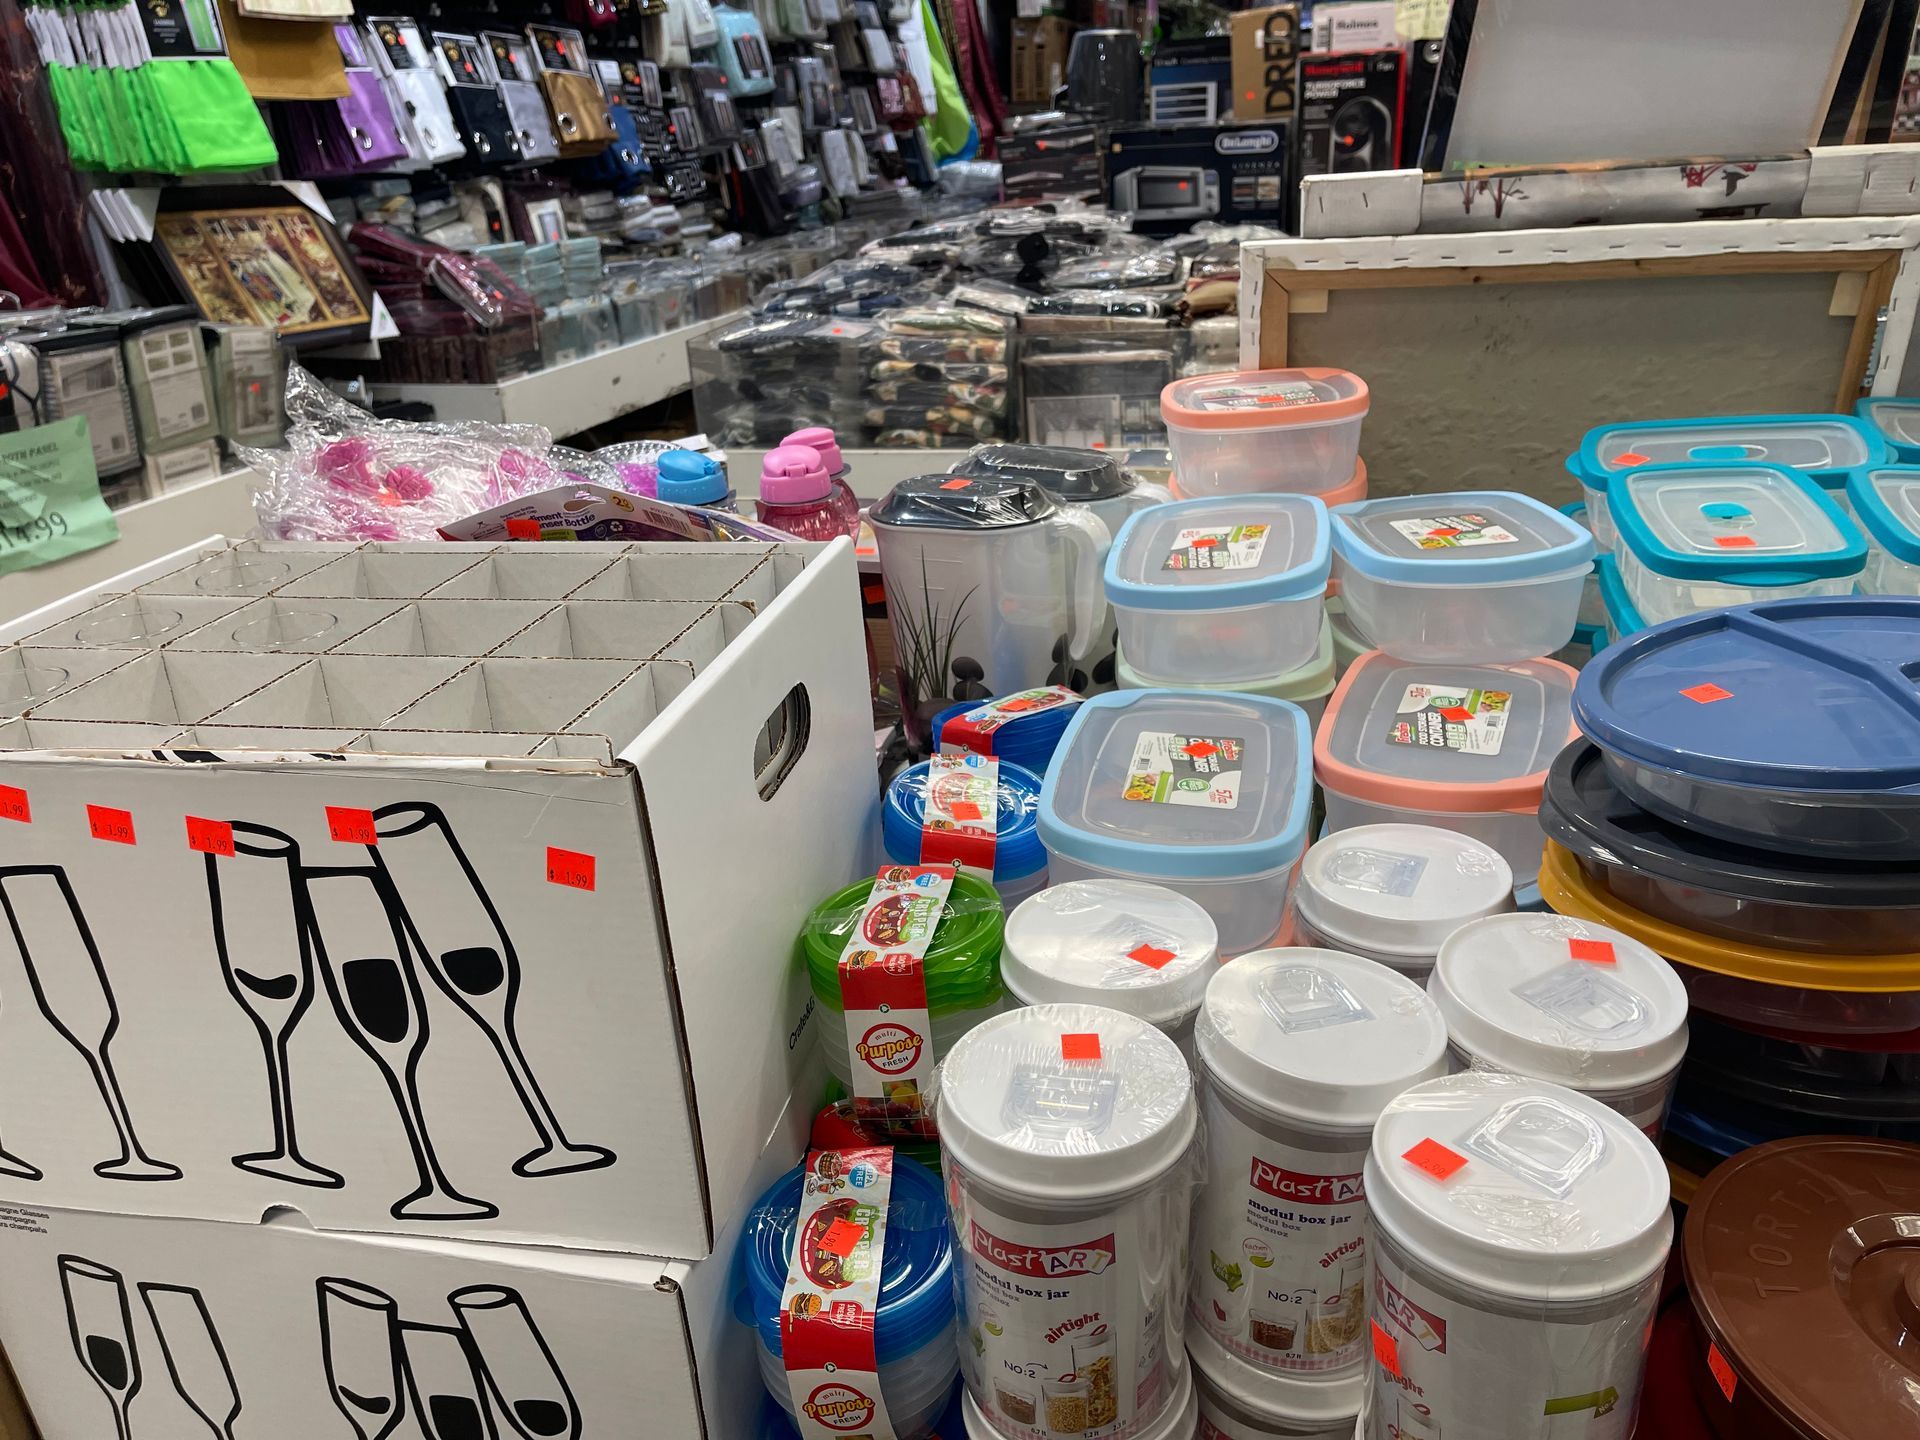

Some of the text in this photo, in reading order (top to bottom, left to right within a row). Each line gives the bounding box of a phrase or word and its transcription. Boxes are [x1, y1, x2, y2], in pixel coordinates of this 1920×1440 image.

[565, 513, 596, 528] Bottle
[3, 802, 24, 817] 1.99
[107, 824, 128, 838] 1.99
[348, 827, 370, 841] 1.99
[206, 836, 227, 851] 1.99
[566, 871, 588, 888] 1.99
[911, 898, 931, 938] CRISPER
[874, 1030, 897, 1041] multi
[856, 1034, 924, 1061] Purpose
[882, 1055, 909, 1069] FRESH
[855, 1164, 864, 1186] FREE
[19, 1208, 50, 1220] Glasses
[1247, 1208, 1302, 1232] modul box
[1248, 1198, 1351, 1226] modul box jar
[1246, 1216, 1289, 1238] kavanoz
[824, 1231, 841, 1248] 1.99
[1318, 1235, 1364, 1269] airtigh
[974, 1262, 1070, 1300] modul box jar
[1002, 1290, 1021, 1302] box
[1267, 1289, 1303, 1305] NO:2
[1043, 1312, 1102, 1344] airtight
[1003, 1359, 1037, 1379] NO:2
[822, 1390, 845, 1400] multi
[802, 1397, 876, 1420] Purpose
[833, 1415, 862, 1425] FRESH
